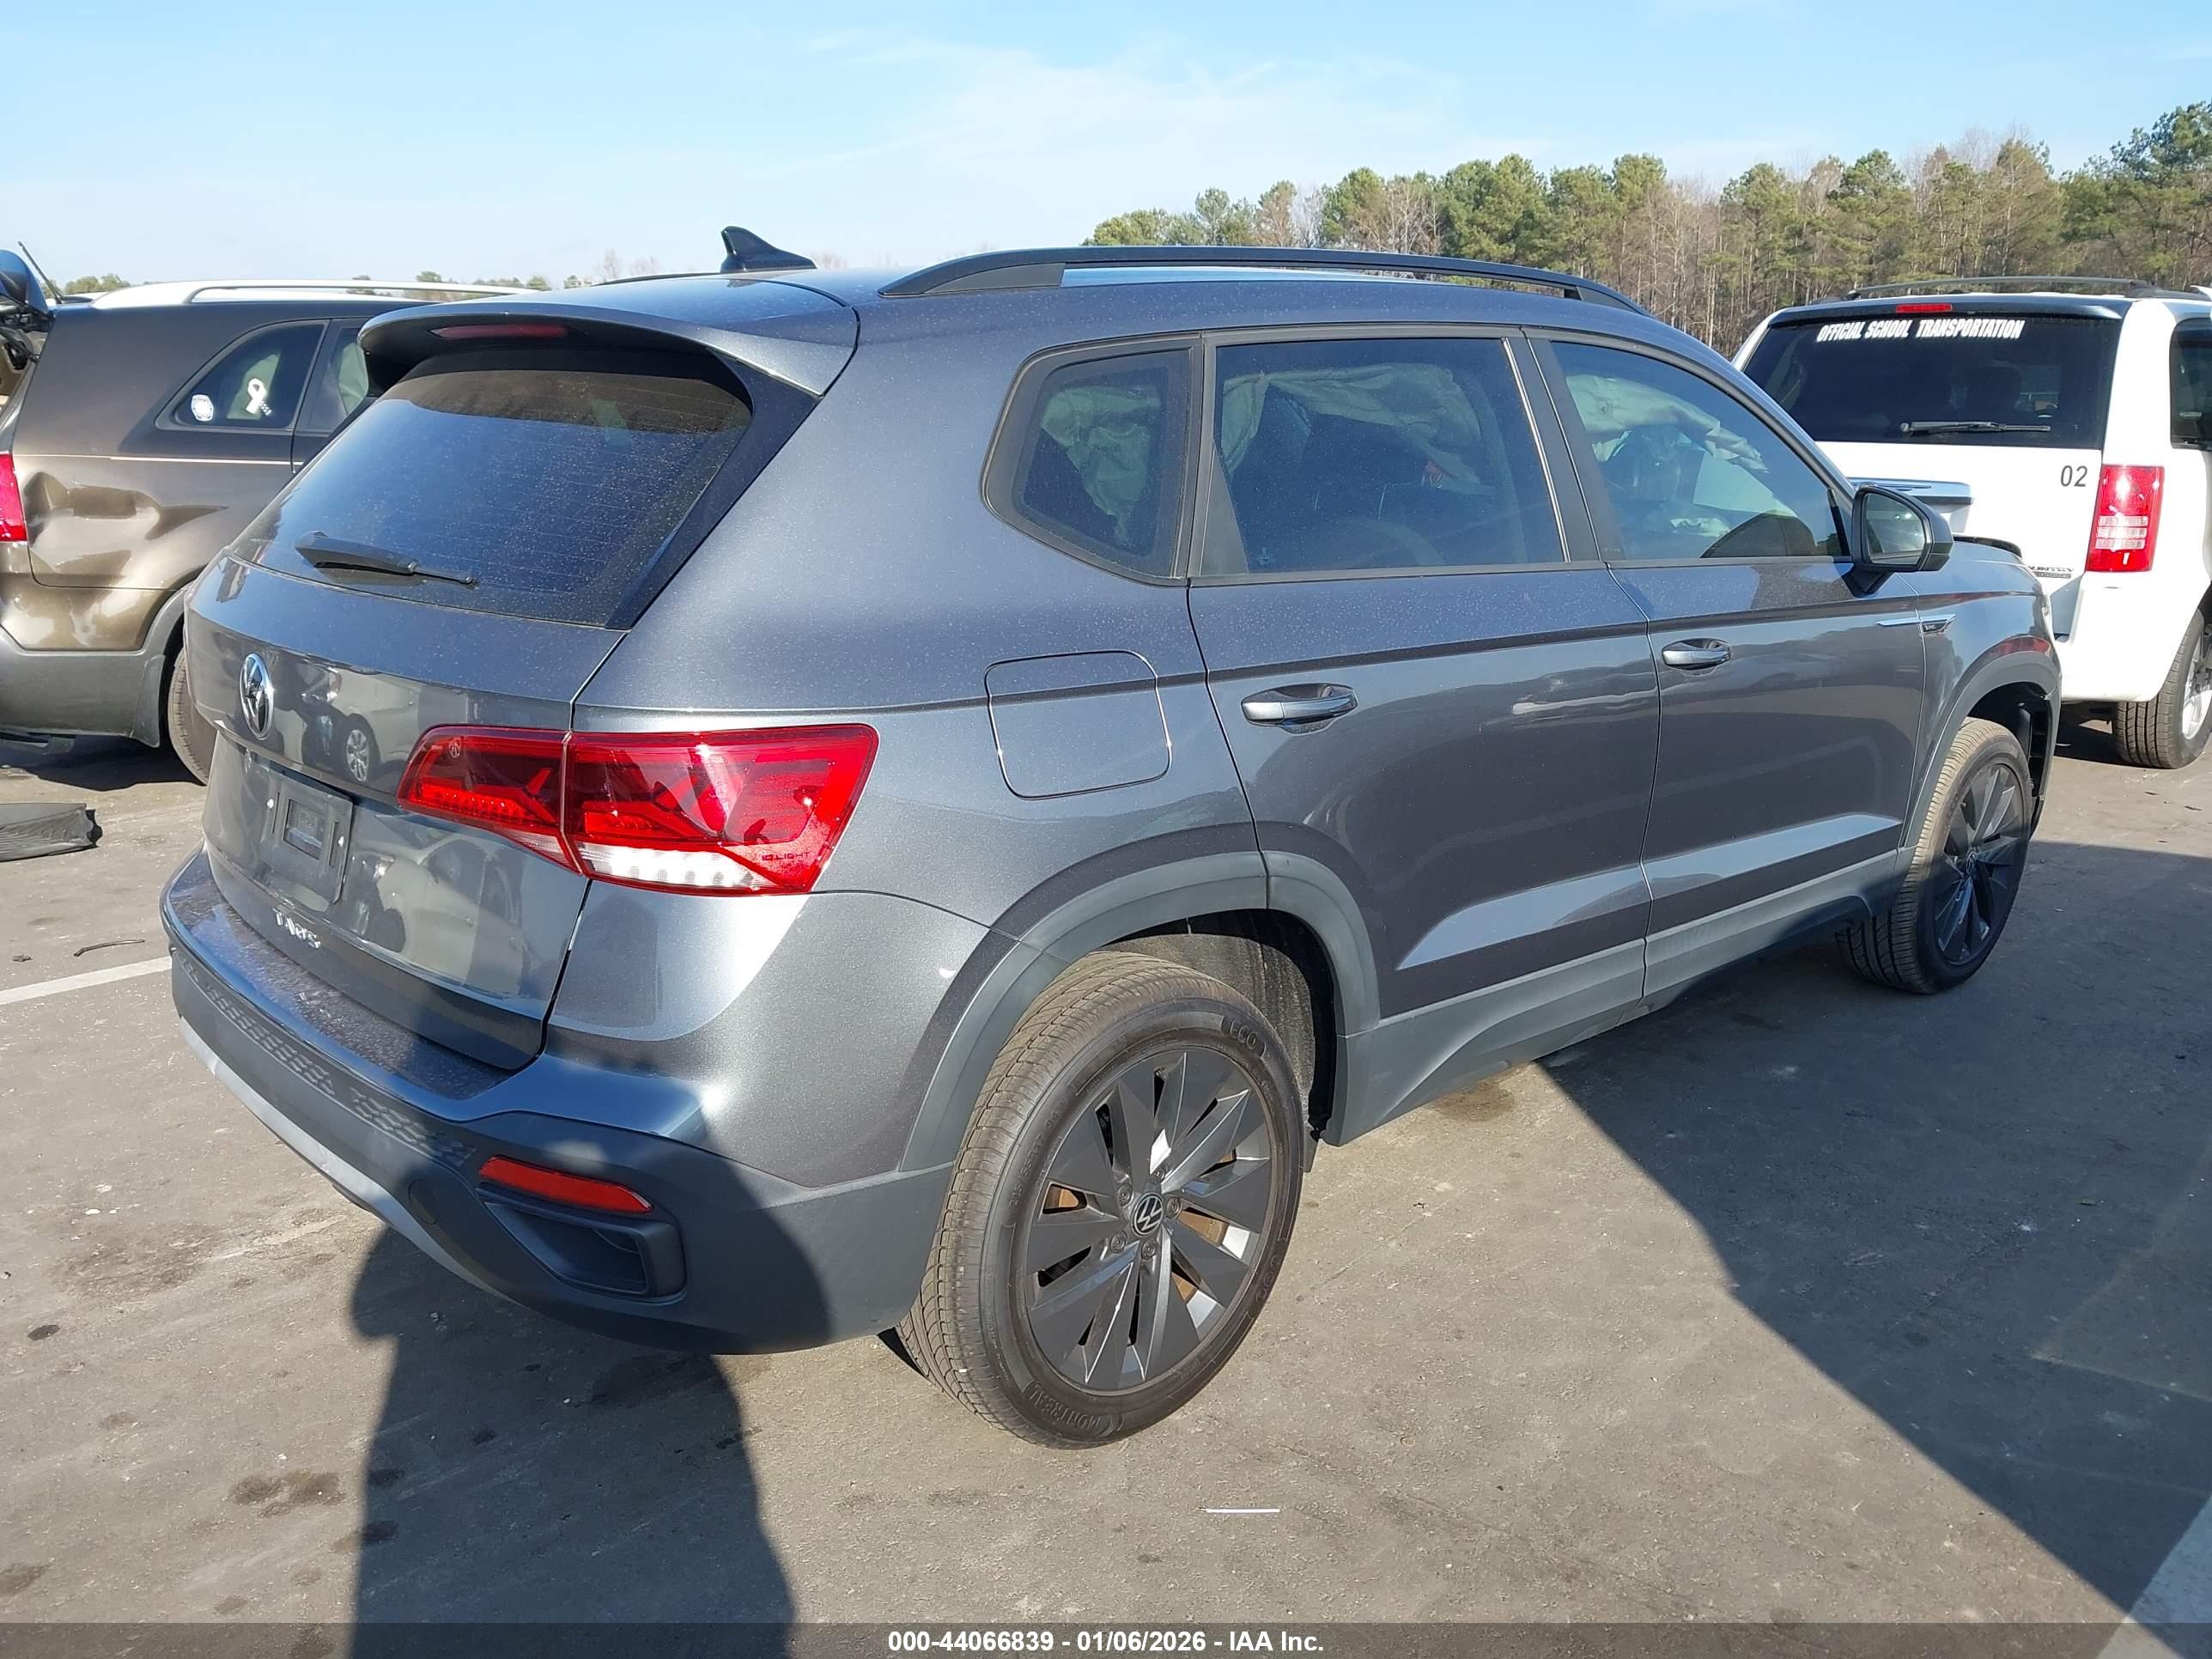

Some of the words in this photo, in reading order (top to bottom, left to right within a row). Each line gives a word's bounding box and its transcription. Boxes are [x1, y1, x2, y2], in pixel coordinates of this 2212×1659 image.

[1816, 322, 1864, 342] OFFICIAL
[1864, 320, 1913, 338] SCHOOL
[1916, 319, 2025, 339] TRANSPORTATION
[2060, 465, 2088, 487] 02
